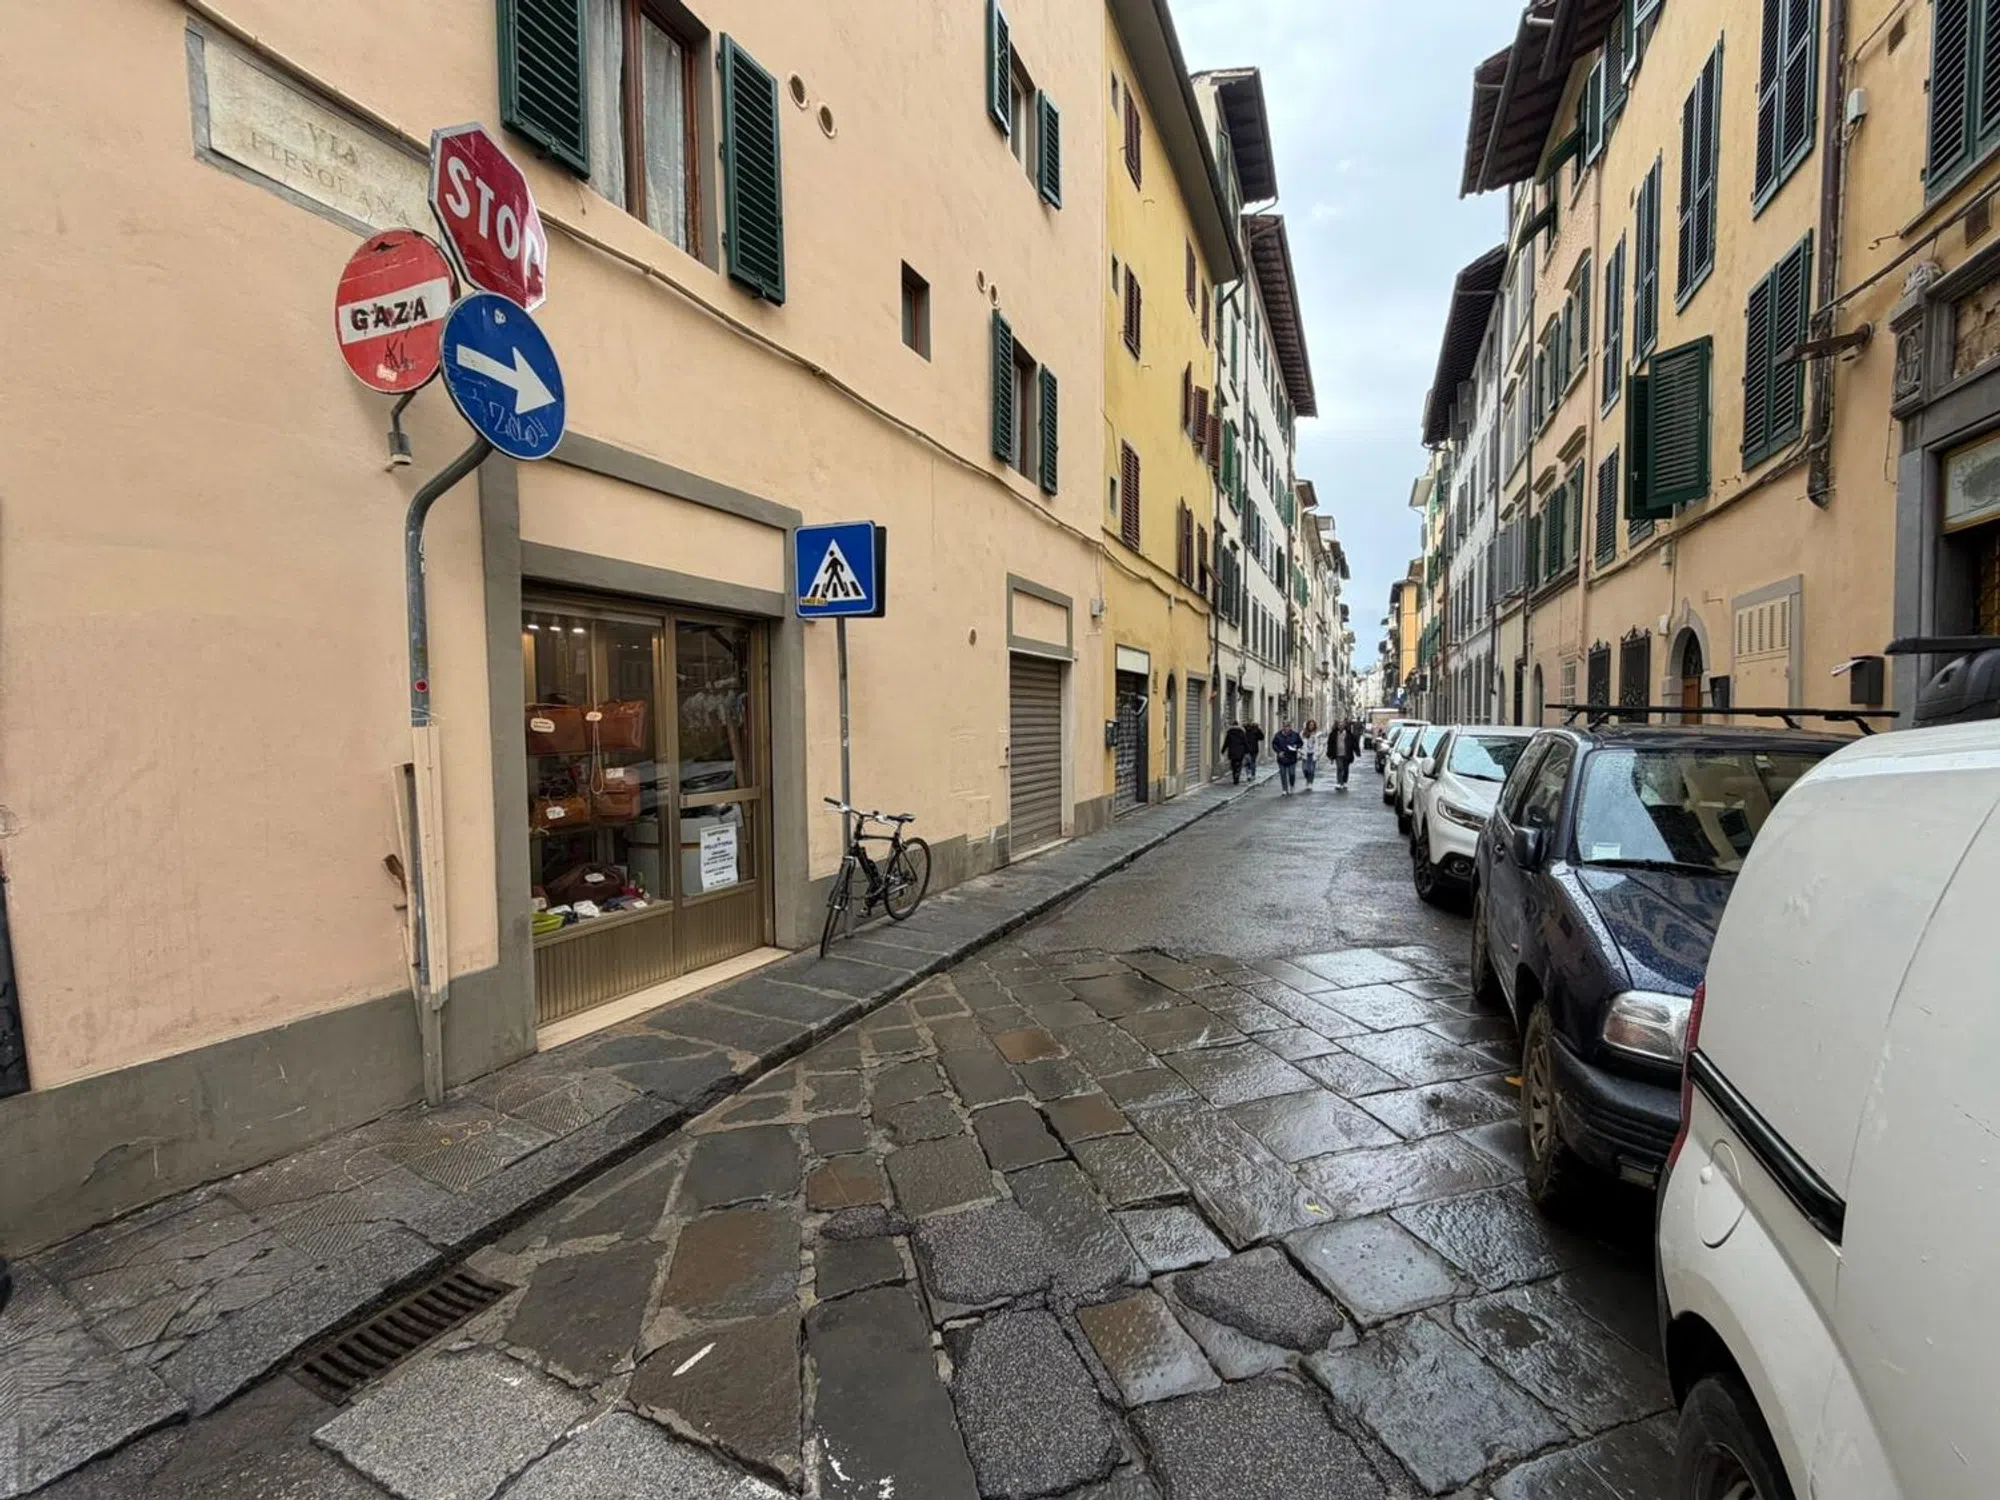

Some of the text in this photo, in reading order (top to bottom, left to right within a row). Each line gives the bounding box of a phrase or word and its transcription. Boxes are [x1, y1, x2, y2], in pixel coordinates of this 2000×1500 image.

[305, 121, 358, 165] VIA
[250, 131, 412, 227] FIESOLANA
[445, 155, 541, 279] STOP
[351, 296, 428, 331] GAZA
